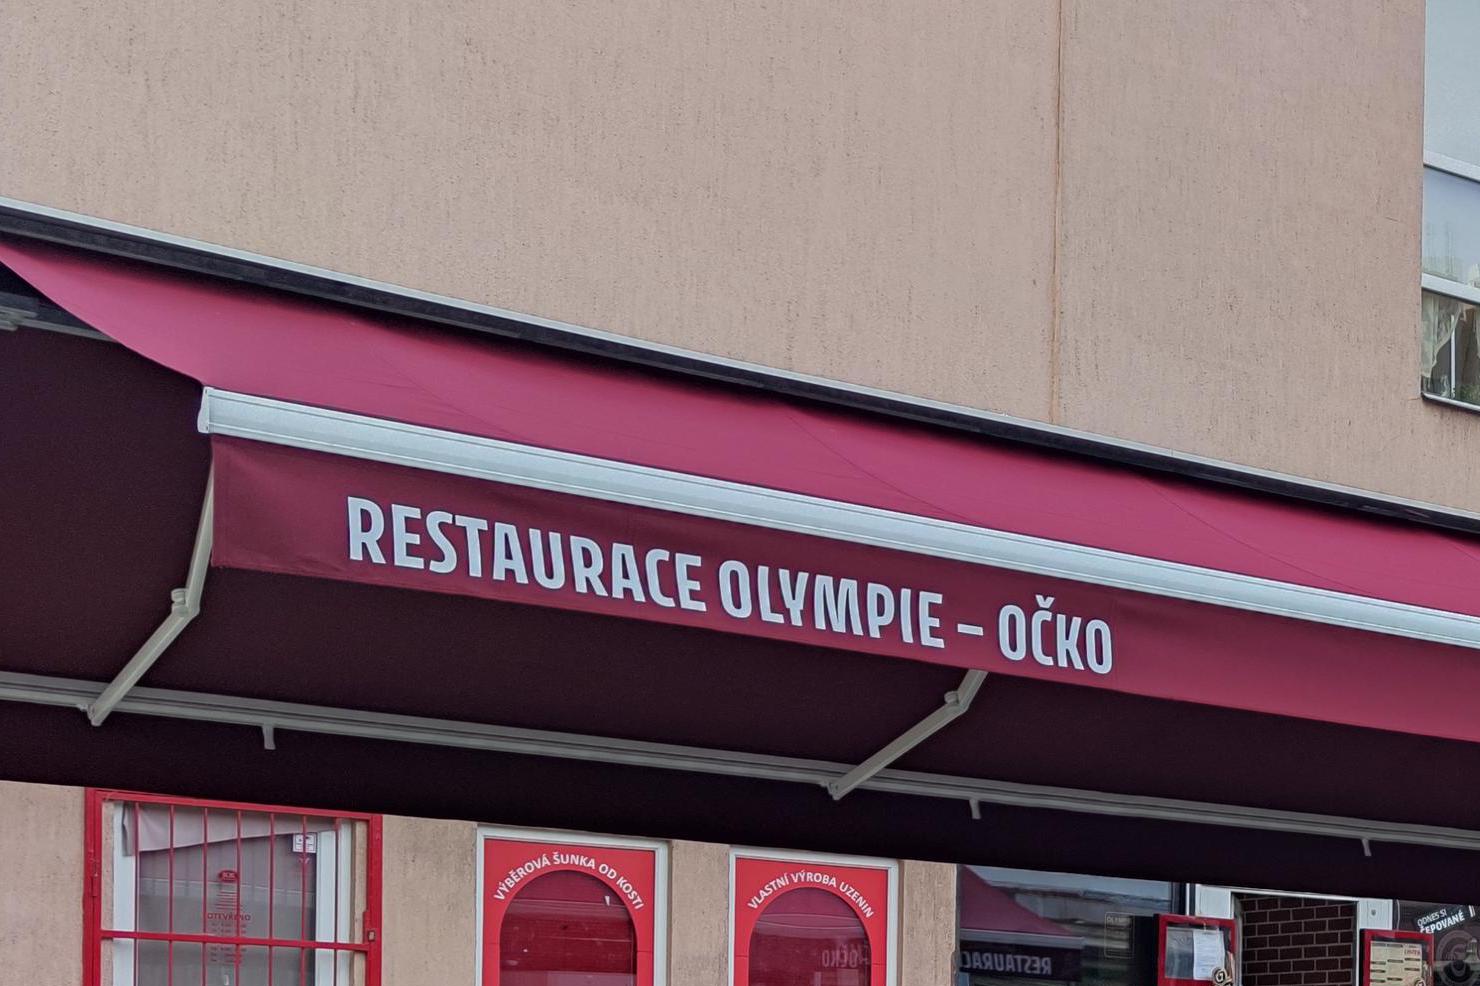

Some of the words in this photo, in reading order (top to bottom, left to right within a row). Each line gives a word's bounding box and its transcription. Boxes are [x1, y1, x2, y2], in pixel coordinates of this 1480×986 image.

[347, 496, 707, 613] RESTAURACE
[720, 559, 945, 649] OLYMPIE
[999, 595, 1114, 675] OČKO
[493, 853, 551, 901] VÝBĚROVÁ
[553, 852, 596, 870] ŠUNKA
[598, 863, 617, 880] OD
[616, 875, 645, 910] KOSTI
[747, 872, 790, 909] VLASTNÍ
[790, 869, 837, 888] VÝROBA
[839, 881, 874, 918] UZENIN
[207, 911, 252, 921] OTEVŘNO
